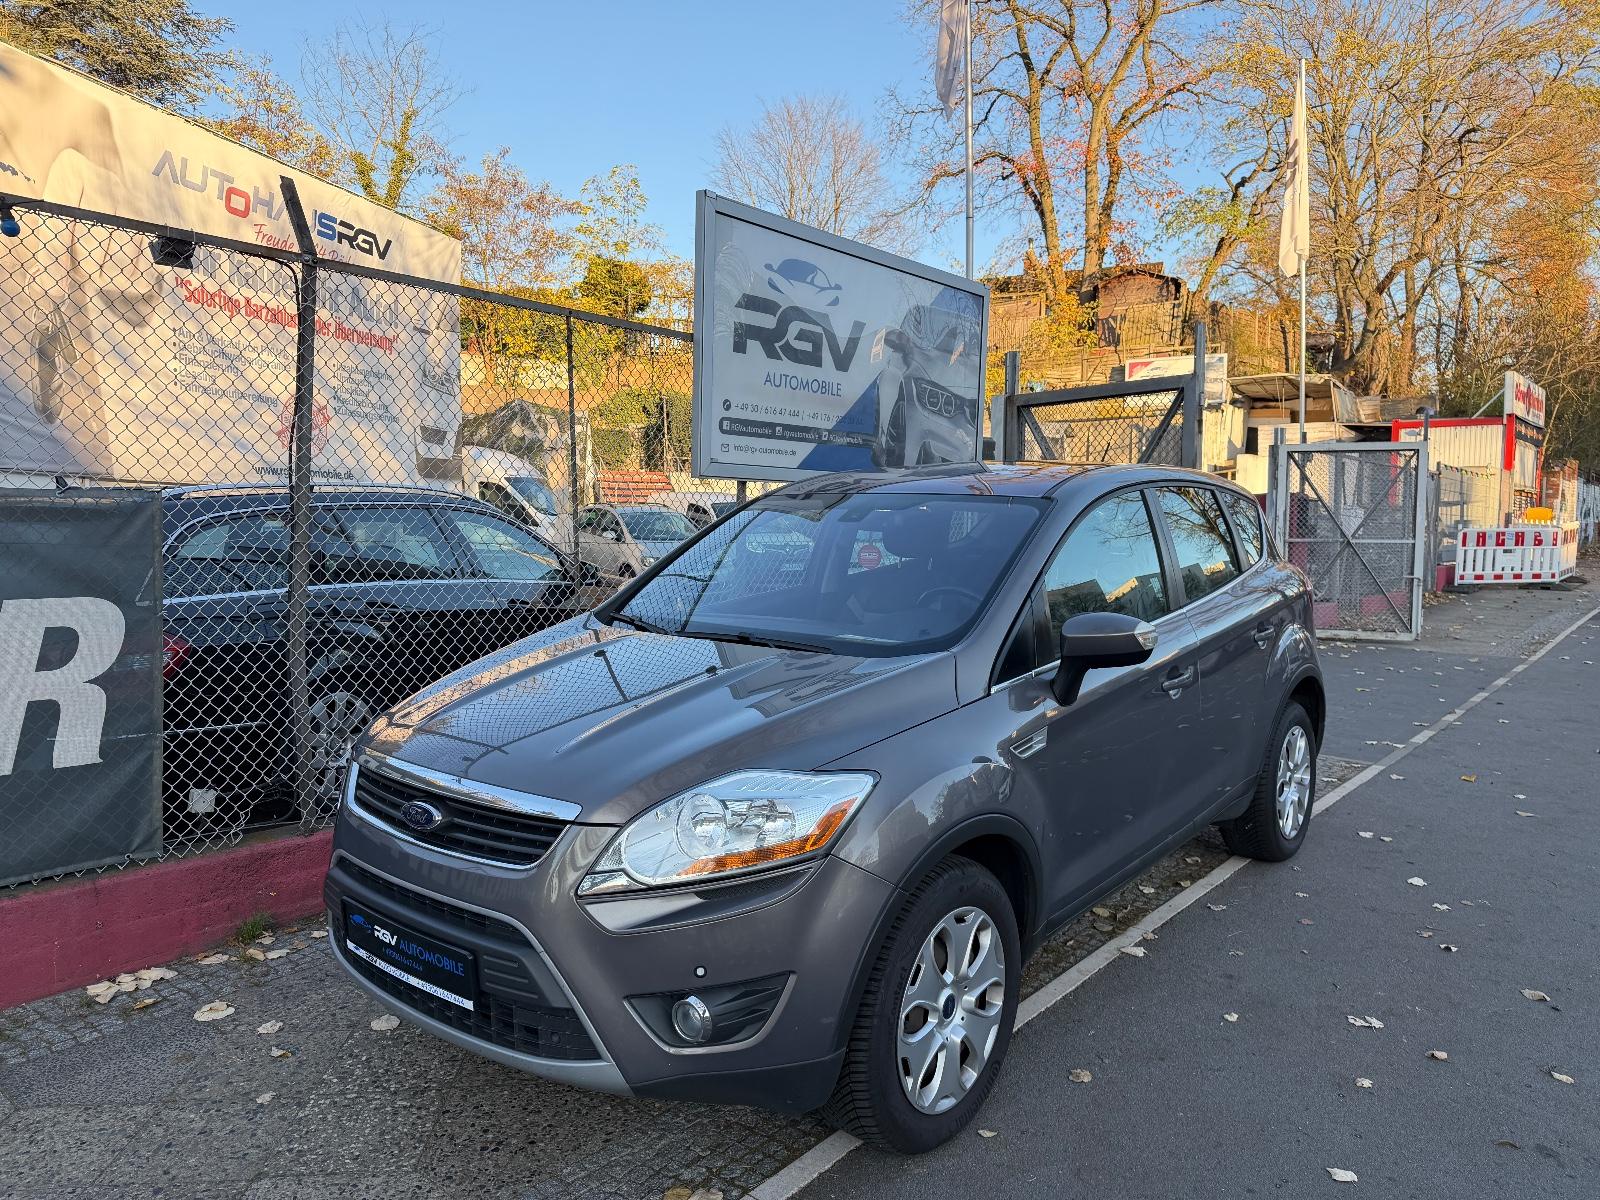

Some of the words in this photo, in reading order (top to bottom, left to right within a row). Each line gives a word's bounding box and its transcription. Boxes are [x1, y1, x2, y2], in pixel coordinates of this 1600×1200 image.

[253, 223, 295, 252] Freude
[733, 293, 866, 373] RGV
[763, 371, 842, 398] AUTOMOBILE
[734, 403, 749, 412] +49
[765, 405, 777, 416] 616
[778, 407, 787, 417] 47
[788, 409, 800, 417] 444
[373, 924, 398, 946] RGV
[399, 940, 465, 977] AUTOMOBILE
